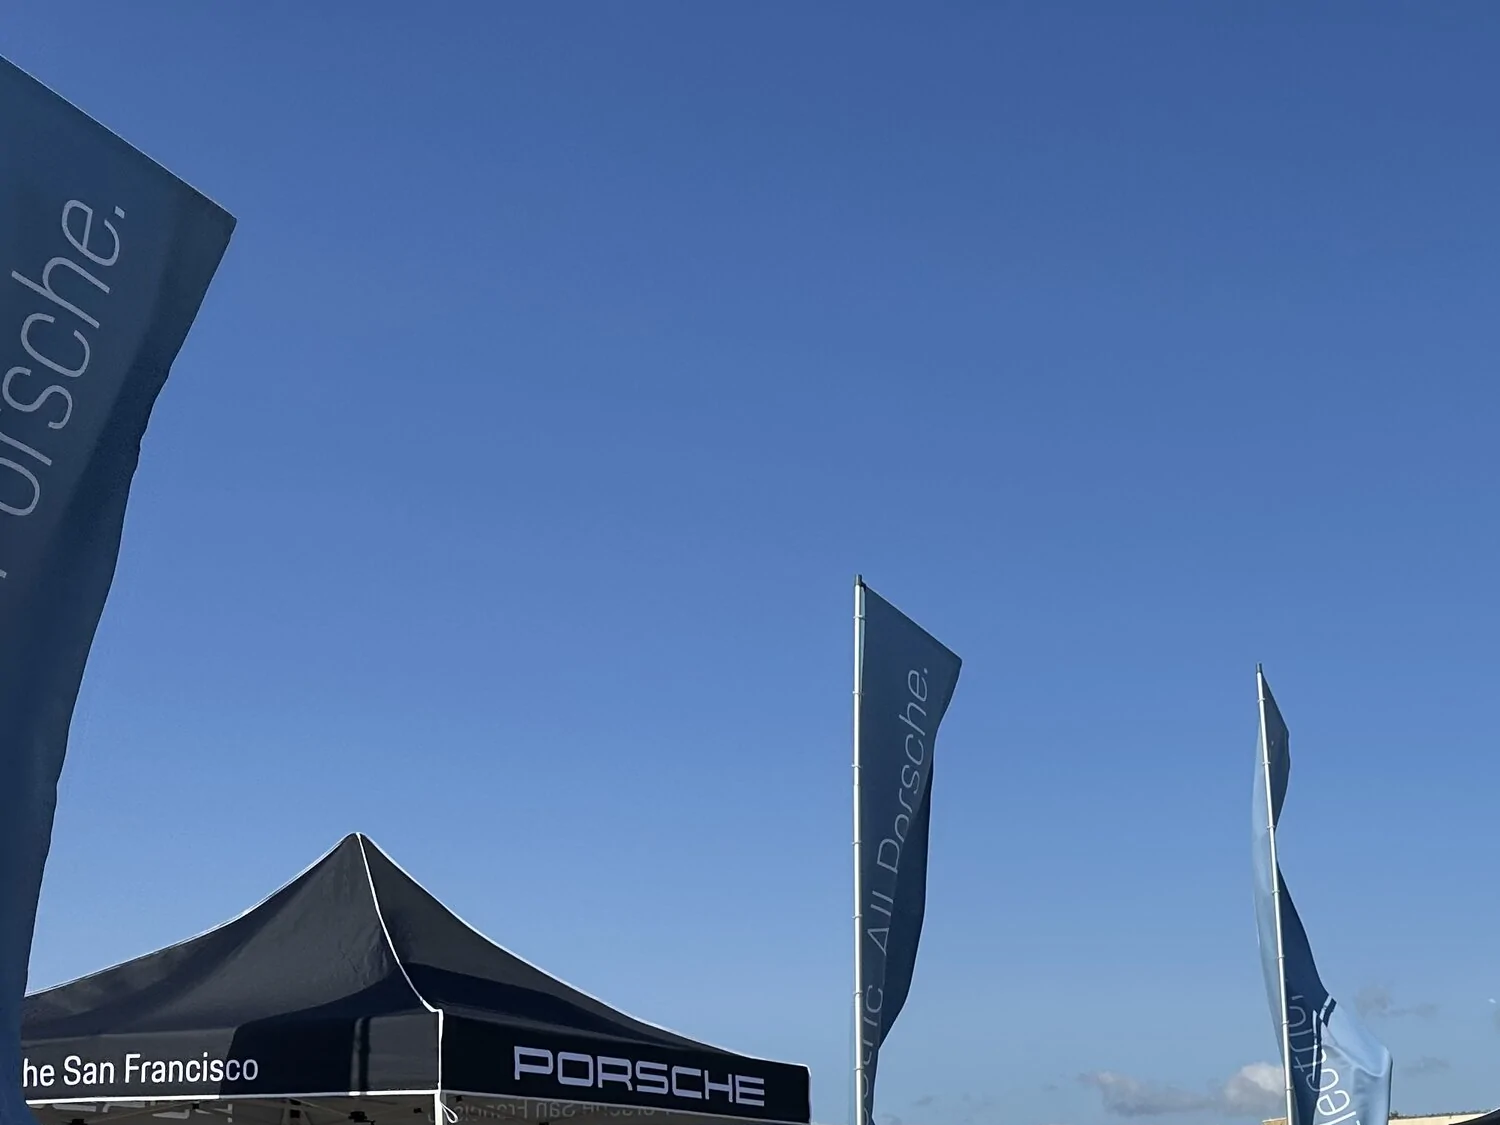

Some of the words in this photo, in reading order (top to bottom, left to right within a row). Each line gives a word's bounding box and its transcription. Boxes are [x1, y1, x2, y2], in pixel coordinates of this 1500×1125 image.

[0, 198, 126, 579] orsche.
[63, 1055, 115, 1086] San
[124, 1052, 259, 1083] Francisco
[514, 1046, 765, 1106] PORSCHE
